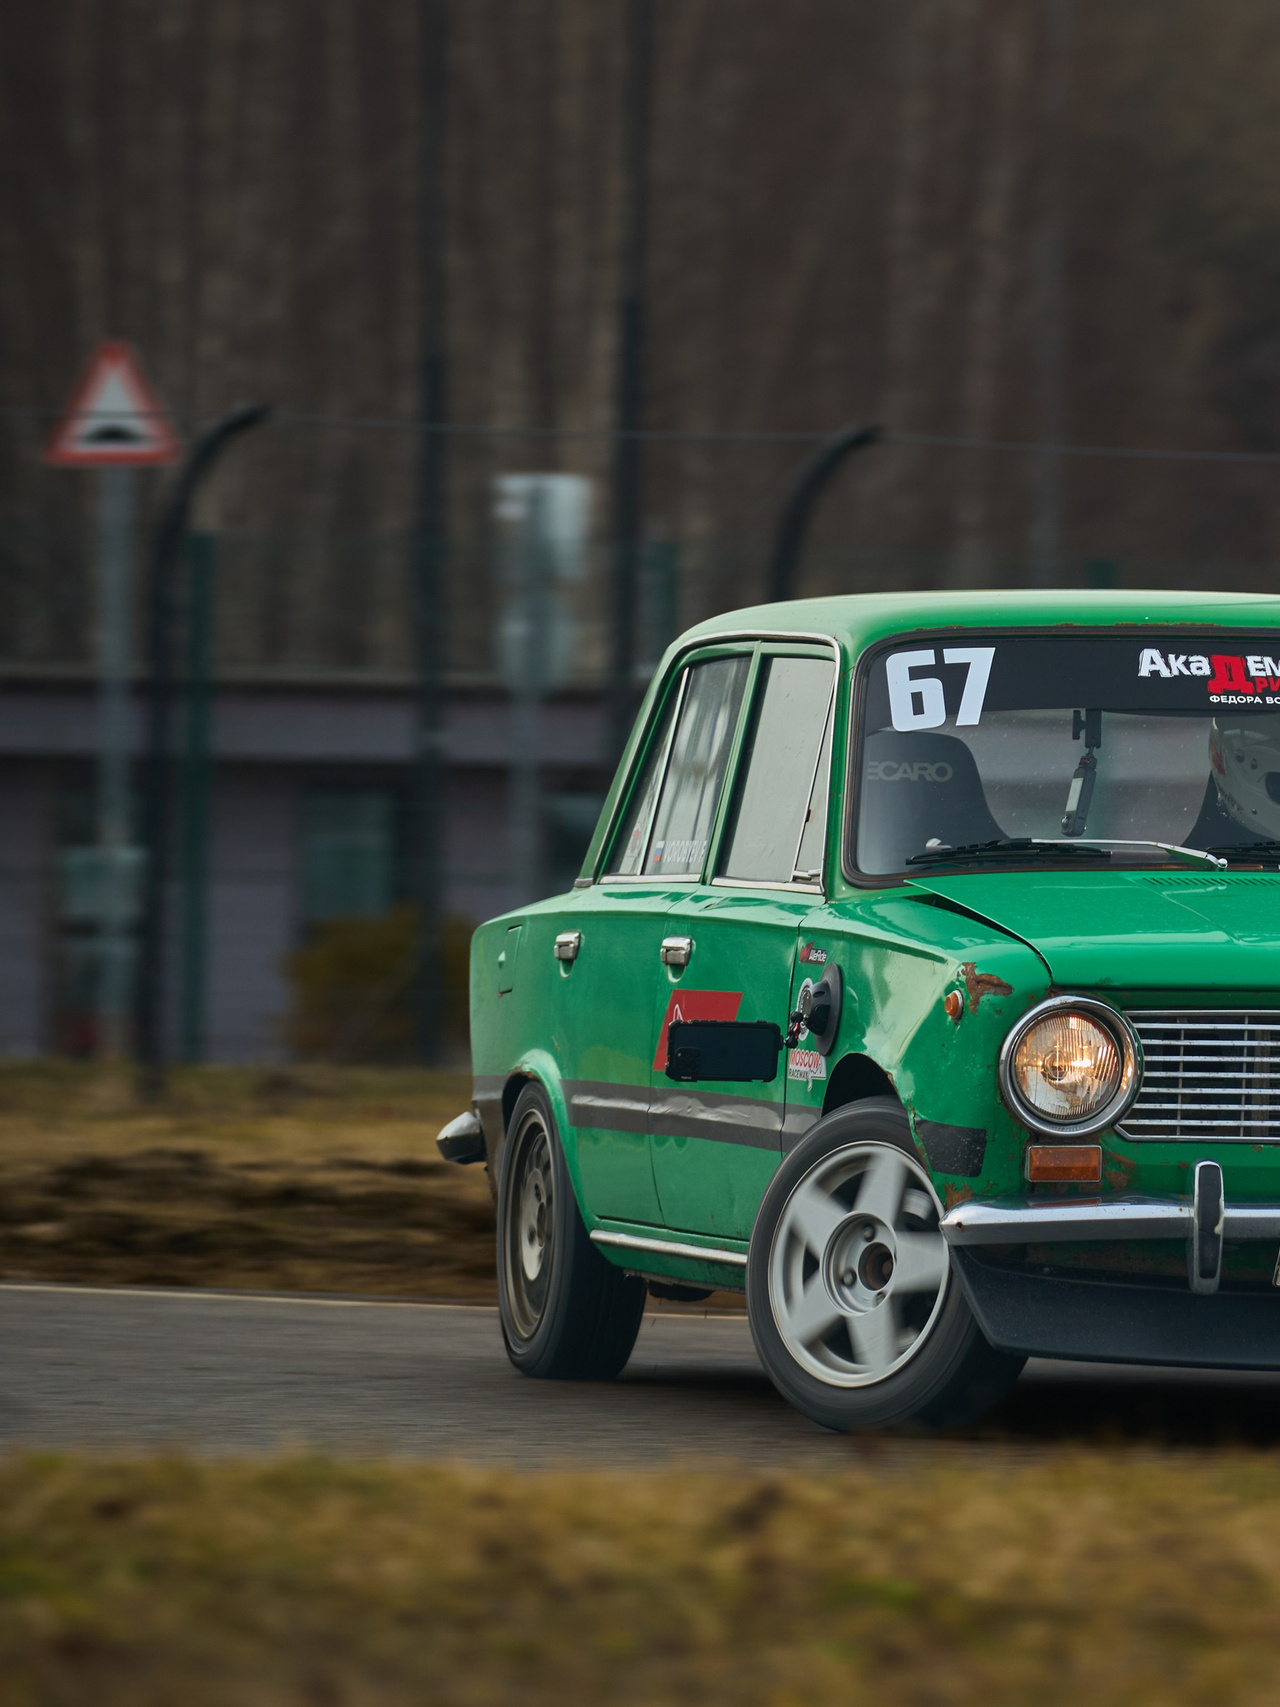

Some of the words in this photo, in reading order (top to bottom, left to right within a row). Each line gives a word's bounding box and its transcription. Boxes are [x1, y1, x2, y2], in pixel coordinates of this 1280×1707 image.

[886, 647, 996, 732] 67
[1209, 695, 1263, 705] ФЕДОРА
[866, 761, 953, 782] ECARO
[789, 1049, 820, 1068] MOSCOW
